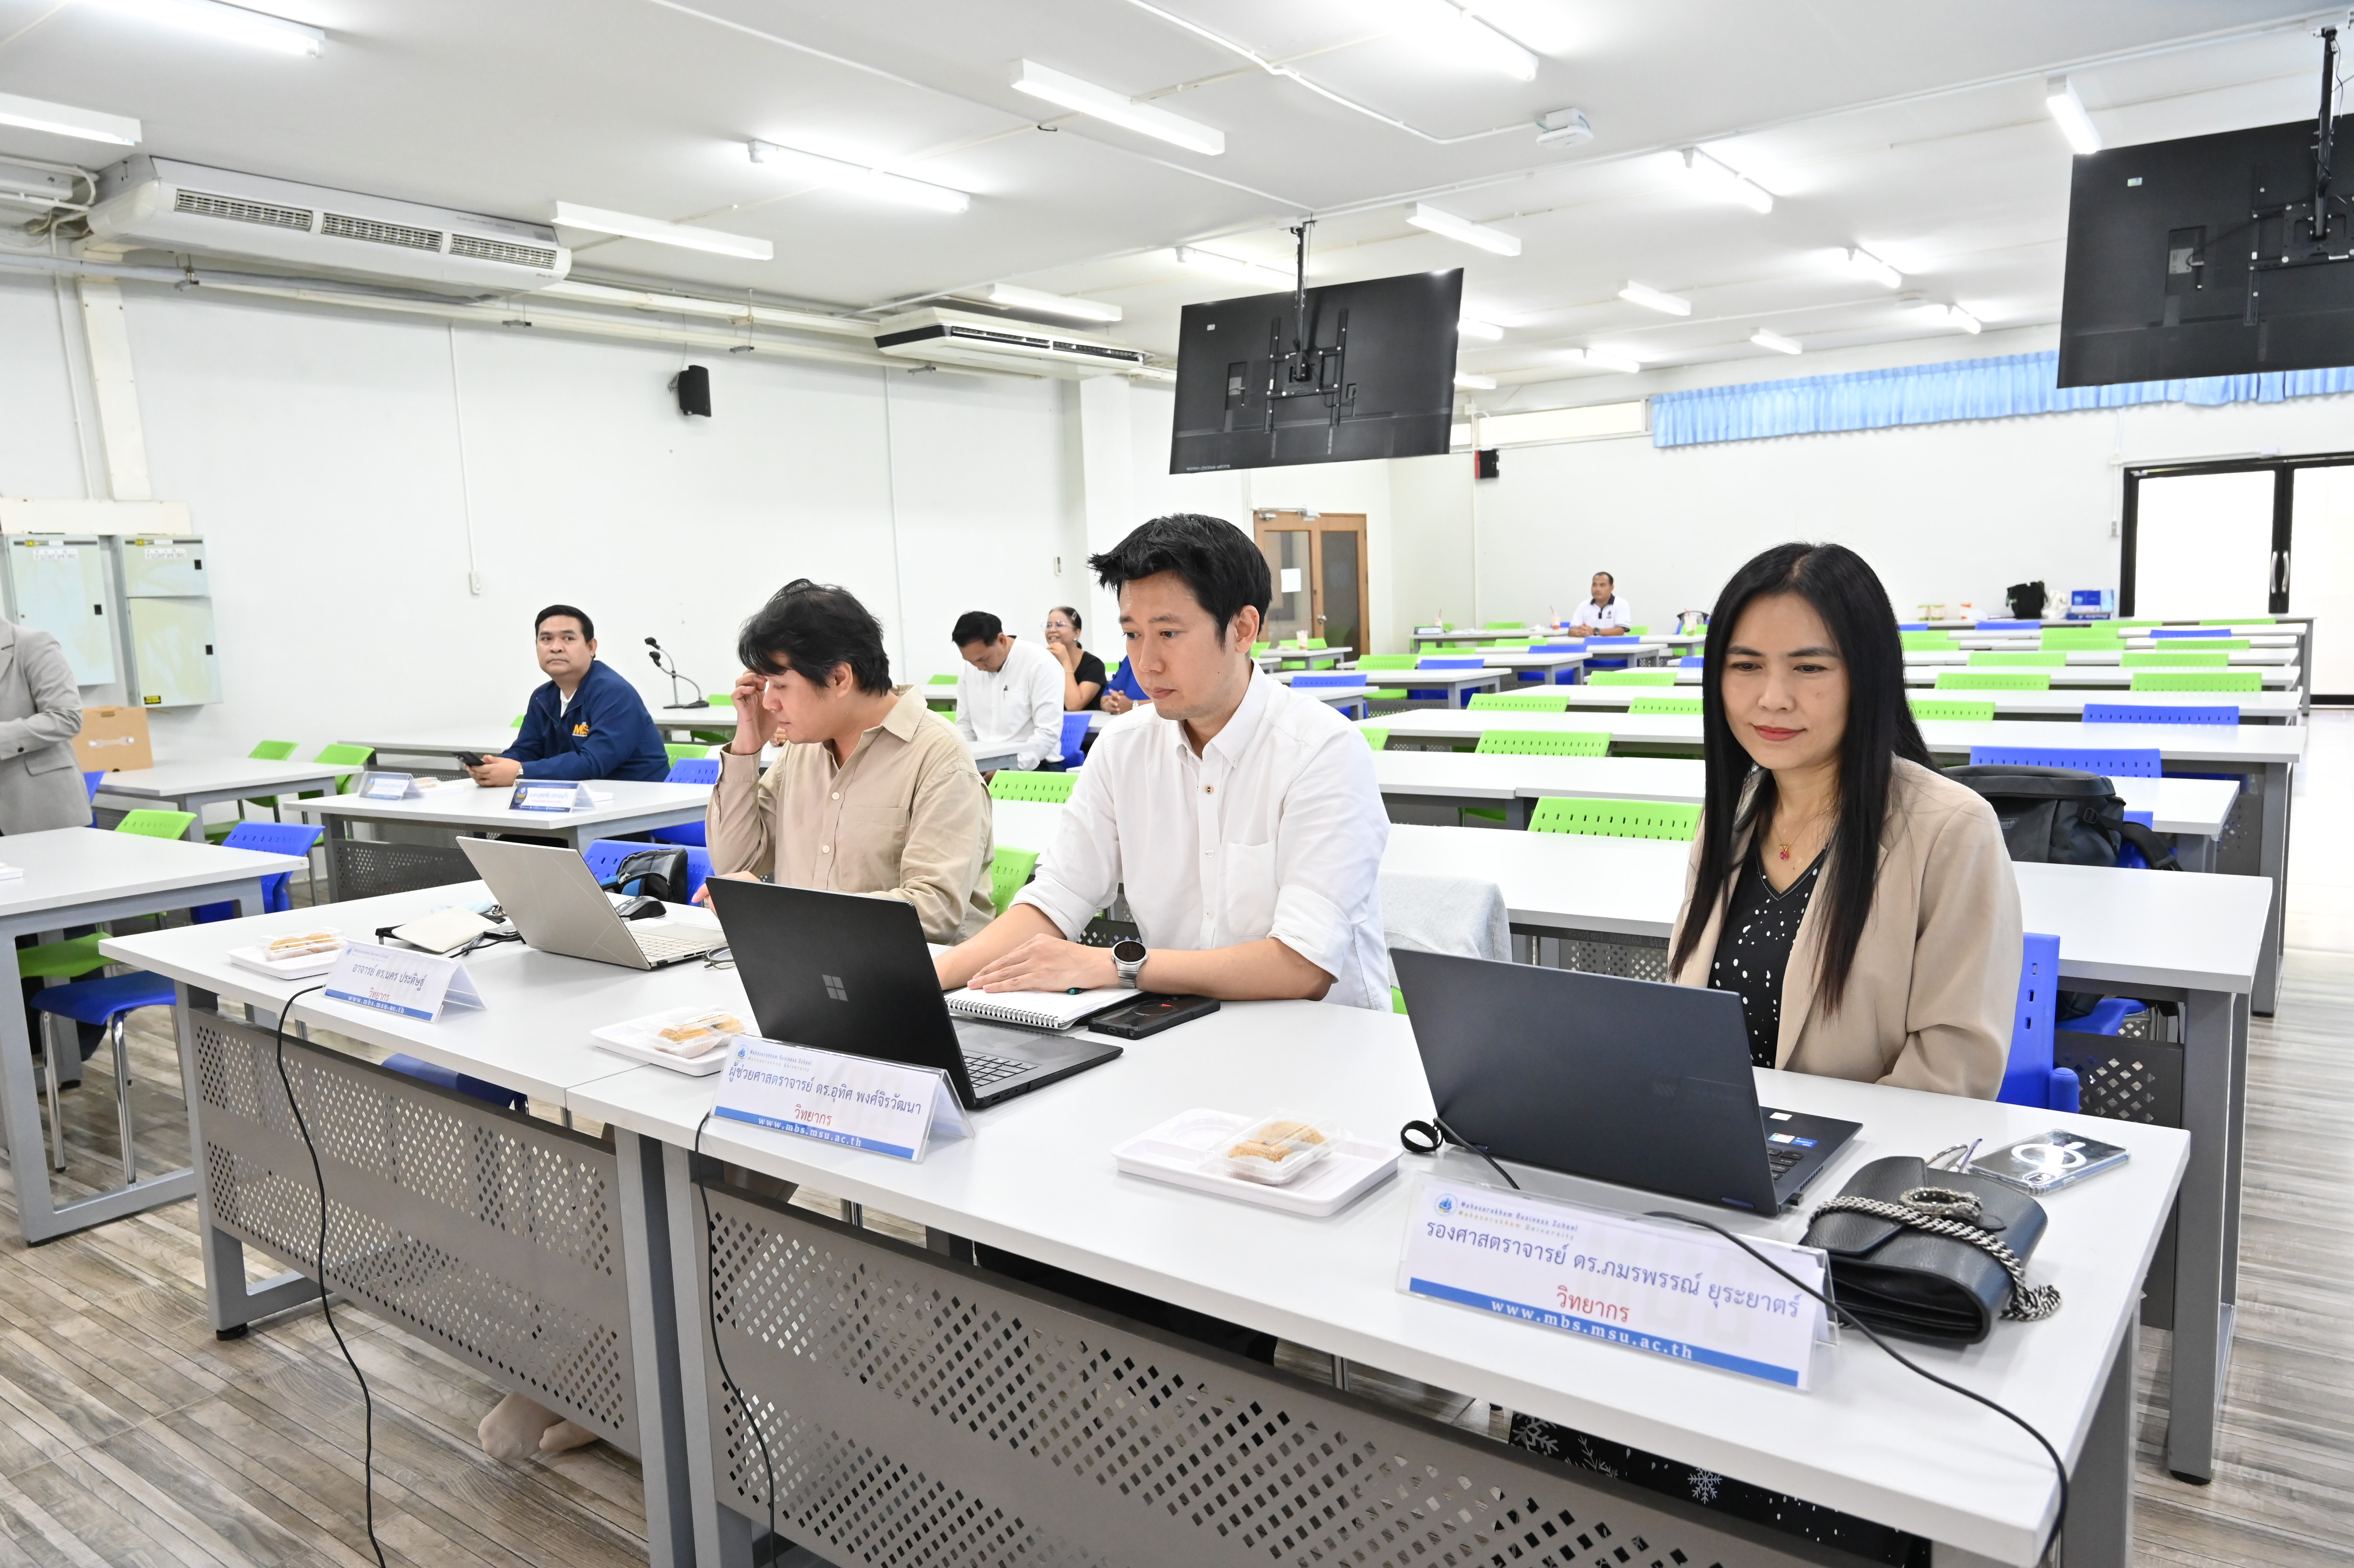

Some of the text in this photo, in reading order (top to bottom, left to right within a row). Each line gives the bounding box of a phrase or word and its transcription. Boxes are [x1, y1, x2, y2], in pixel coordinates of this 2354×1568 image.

[352, 964, 378, 976] อาจารย์
[348, 995, 404, 1013] www.mbs.msu.ac.th
[369, 987, 390, 1002] วิทยากร
[729, 1061, 922, 1115] ผู้ช่วยศาสตราจารย์ ดร.อุทิศ พงศ์จิรวัฒนา
[794, 1103, 833, 1126] วิทยากร
[758, 1118, 862, 1147] www.mbs.msu.ac.th
[1461, 1201, 1579, 1232] Mahasarakham Business School
[1427, 1222, 1802, 1318] รองศาสตราจารย์ ดร.ภมรพรรณ์ ยุระยาตร์
[1556, 1285, 1630, 1323] วิทยากร
[1491, 1300, 1694, 1361] www.mbs.msu.ac.th
